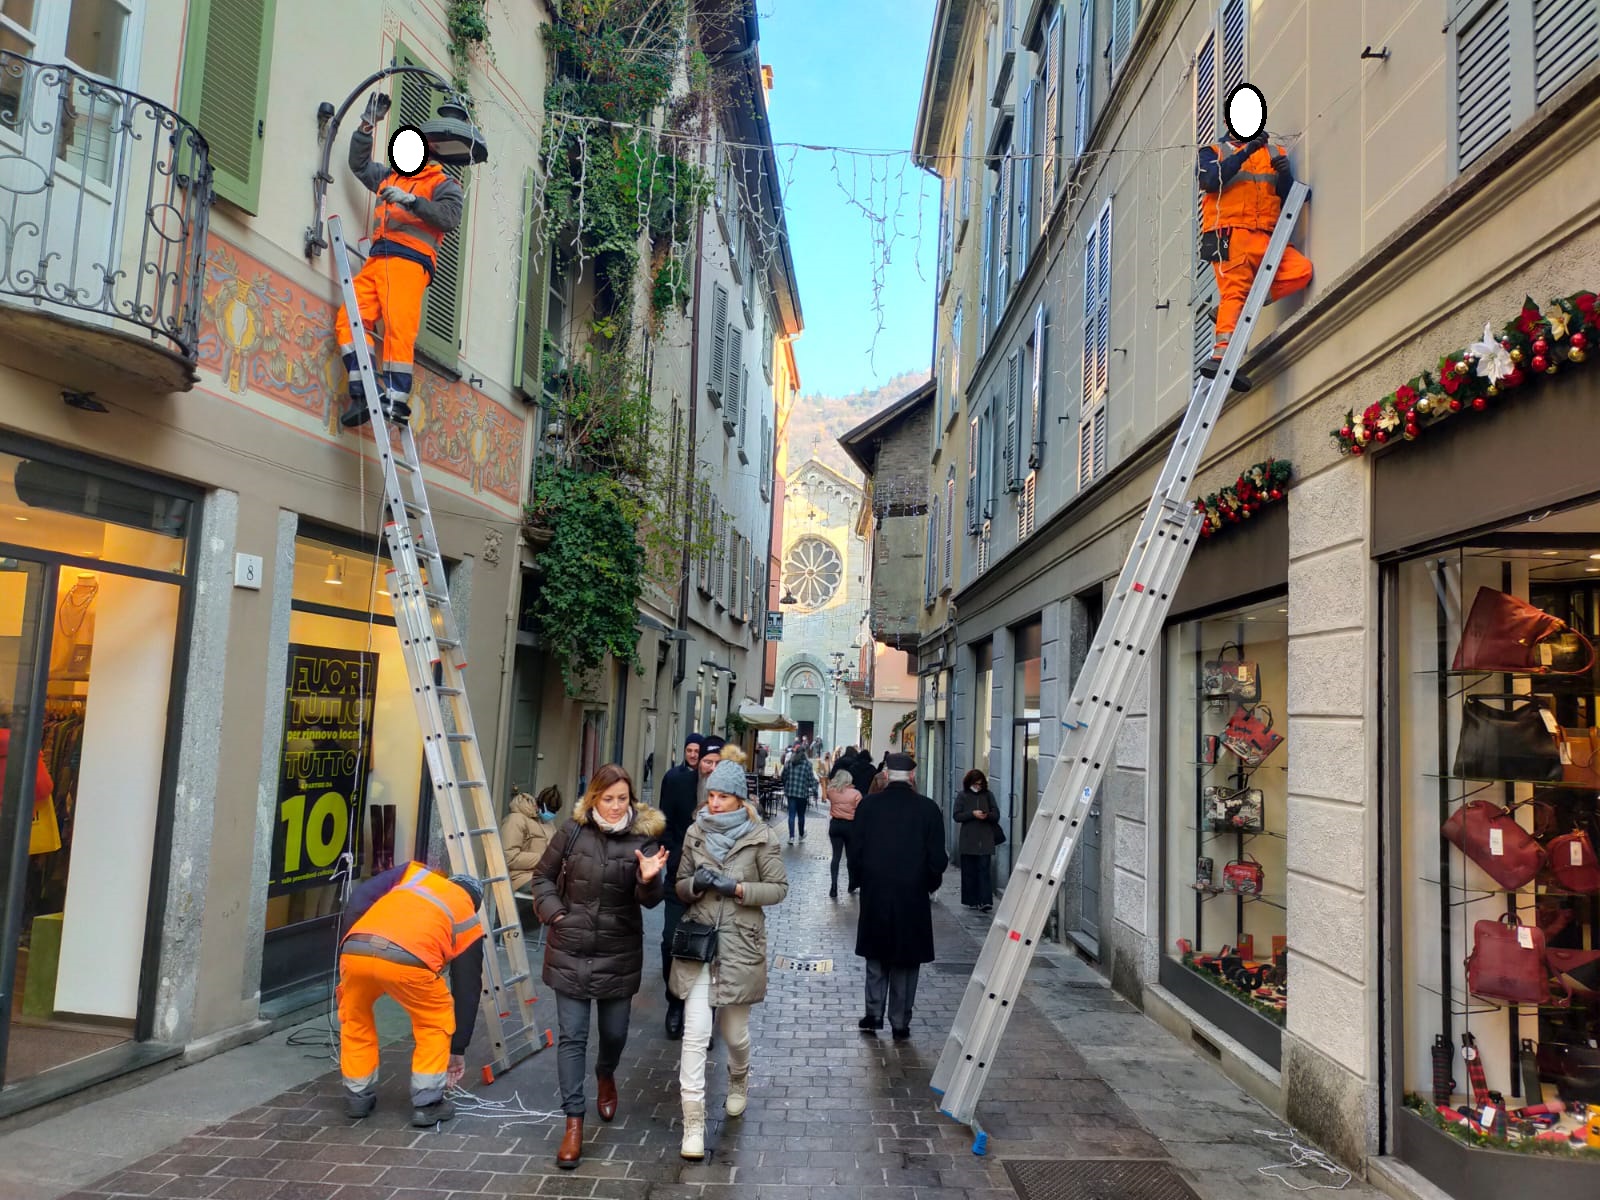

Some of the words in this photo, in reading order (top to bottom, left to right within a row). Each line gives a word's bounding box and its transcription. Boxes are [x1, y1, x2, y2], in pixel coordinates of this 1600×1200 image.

[247, 565, 254, 581] 8
[294, 656, 371, 697] FUORI
[290, 692, 369, 725] TUTTO
[287, 730, 301, 741] per
[302, 728, 338, 740] rinnovo
[285, 749, 358, 780] TUTTO
[280, 791, 348, 873] 10
